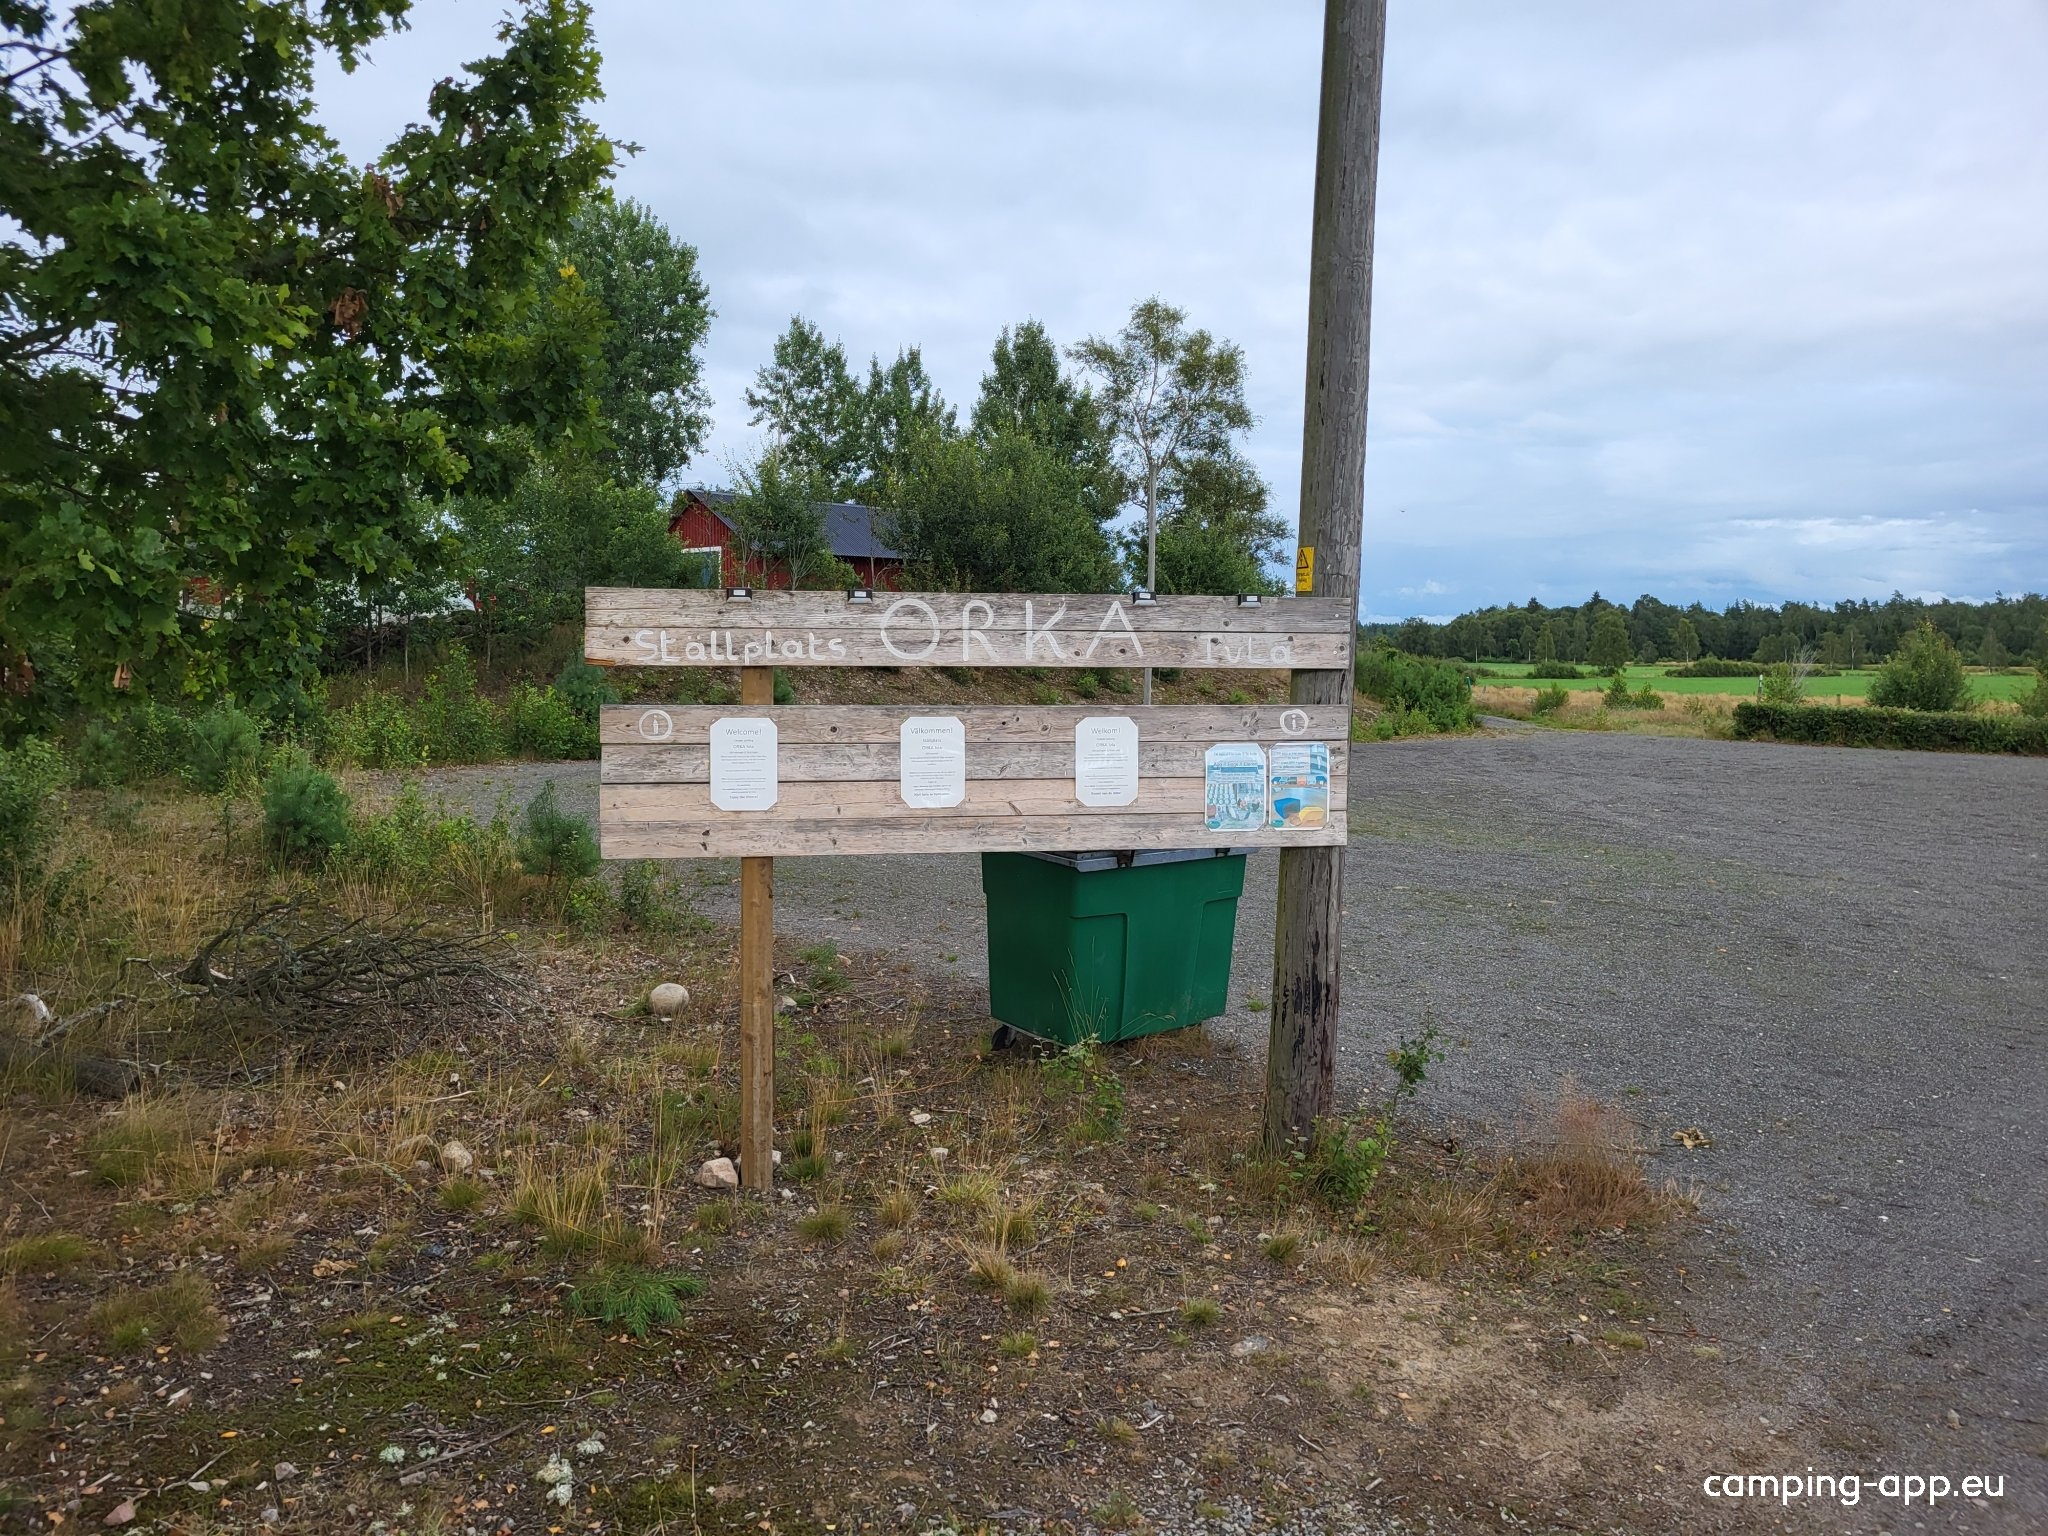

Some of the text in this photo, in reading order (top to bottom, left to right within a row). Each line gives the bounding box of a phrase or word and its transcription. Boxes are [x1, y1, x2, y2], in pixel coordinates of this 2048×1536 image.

[634, 630, 846, 664] Ställplats
[880, 598, 1144, 662] ORKA
[725, 728, 762, 736] Welcome!
